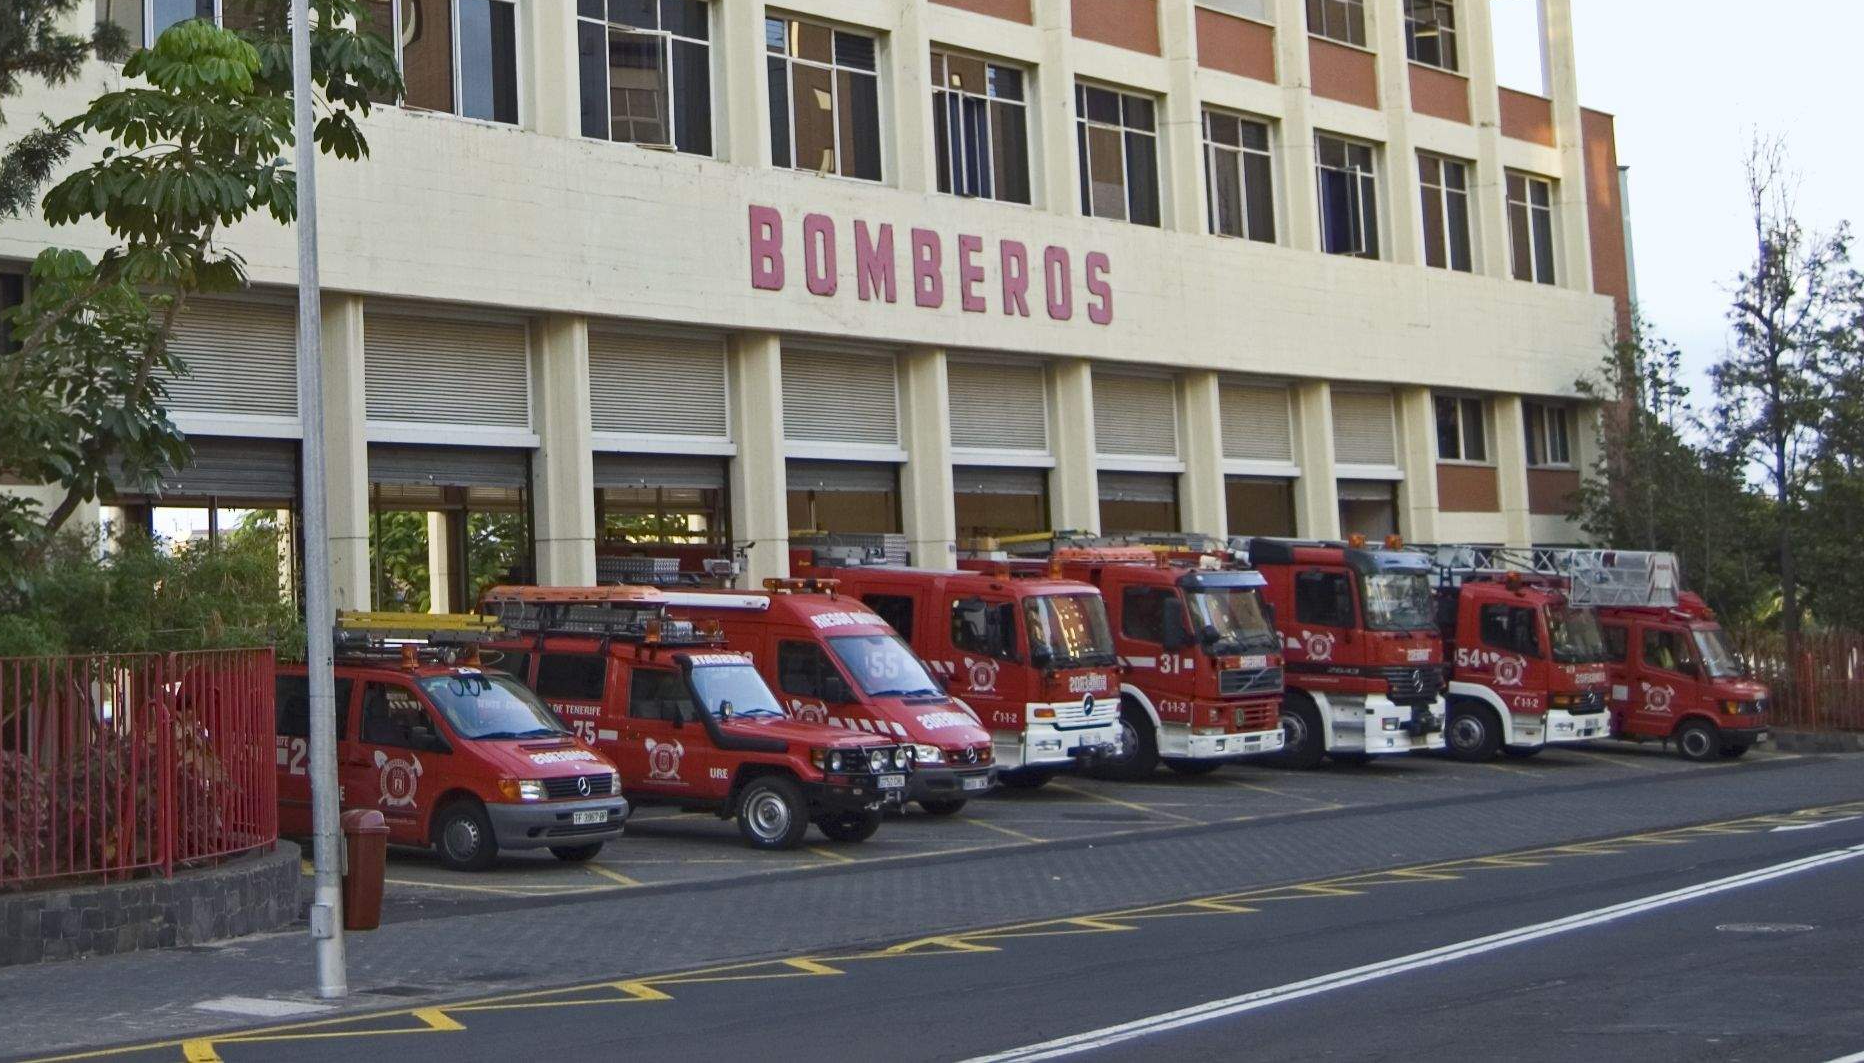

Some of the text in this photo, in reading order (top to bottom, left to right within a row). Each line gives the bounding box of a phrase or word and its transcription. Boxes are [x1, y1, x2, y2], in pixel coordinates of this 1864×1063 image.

[748, 204, 1114, 326] BOMBEROS
[1159, 653, 1180, 675] 31
[1458, 647, 1481, 668] 54
[553, 703, 602, 717] DE TENERIFE
[573, 720, 596, 745] 75
[709, 767, 729, 780] URE
